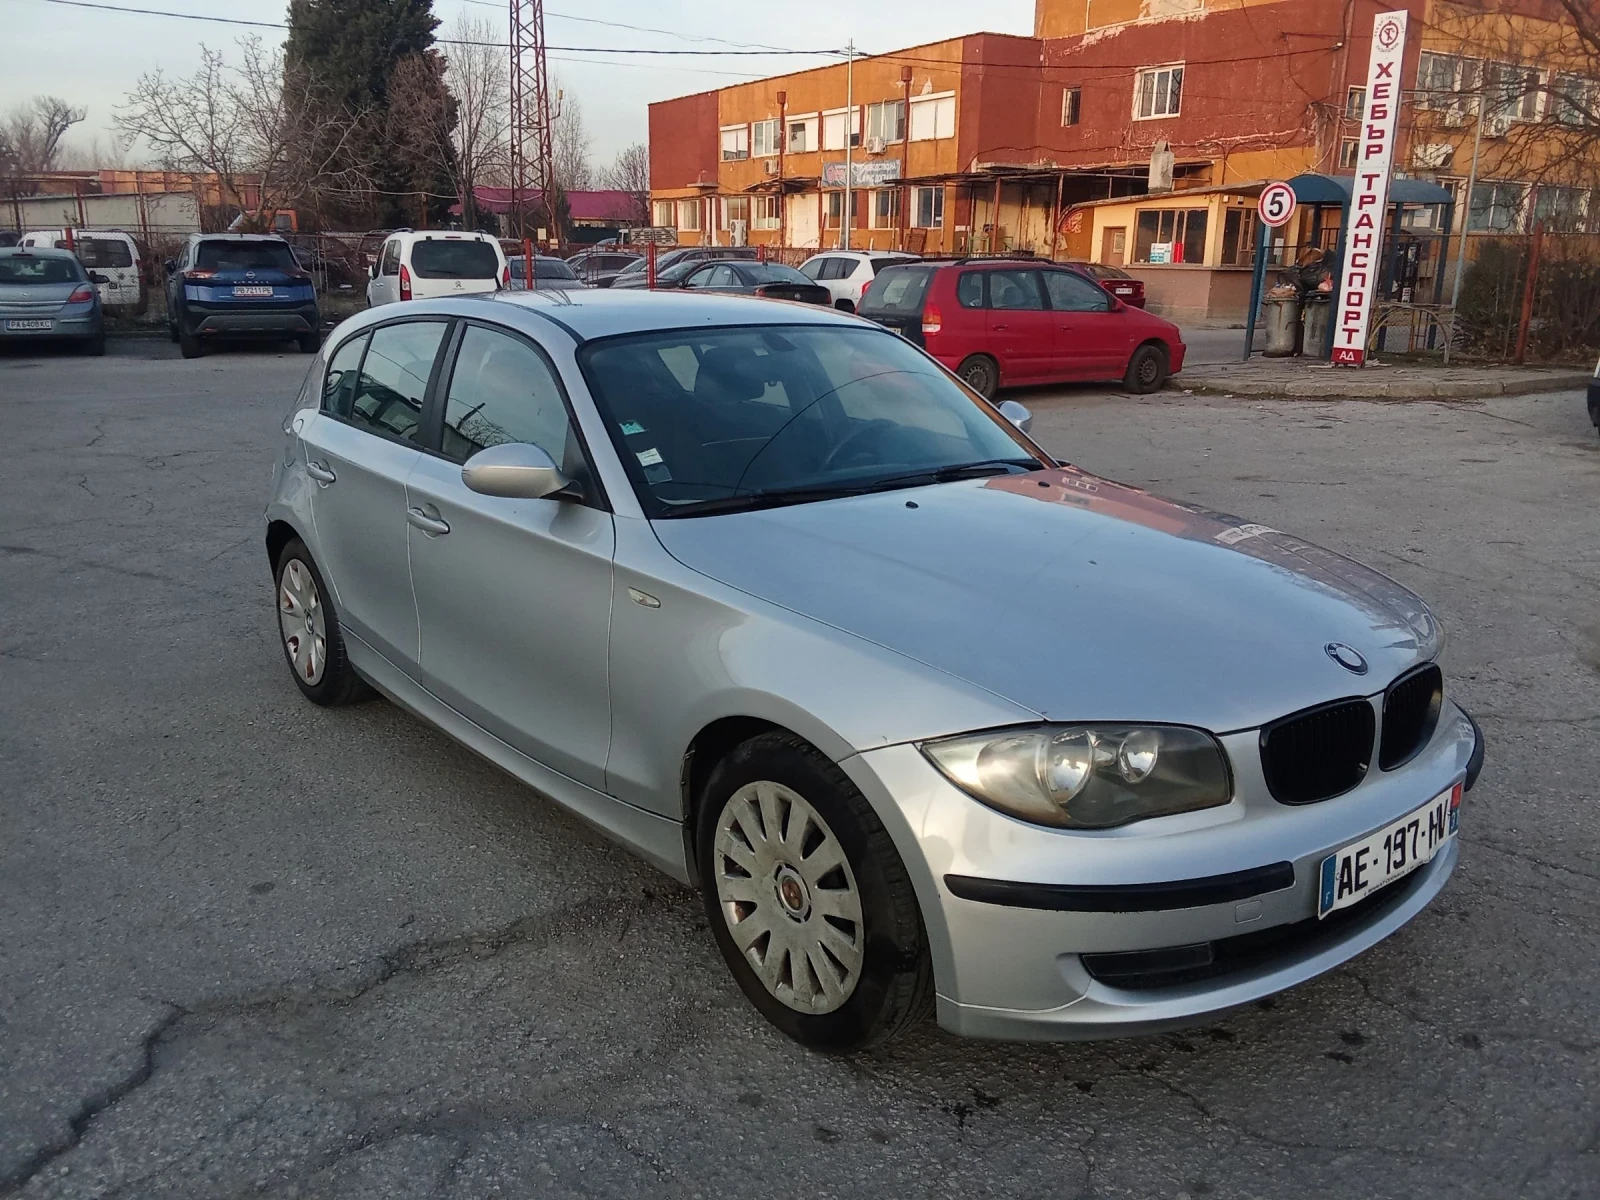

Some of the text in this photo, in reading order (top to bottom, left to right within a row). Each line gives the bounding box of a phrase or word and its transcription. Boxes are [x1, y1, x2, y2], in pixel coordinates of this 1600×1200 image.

[1269, 192, 1284, 217] 5
[1341, 61, 1395, 345] ХЕБЪР ТРАНСПОРТ
[1339, 350, 1355, 361] АД
